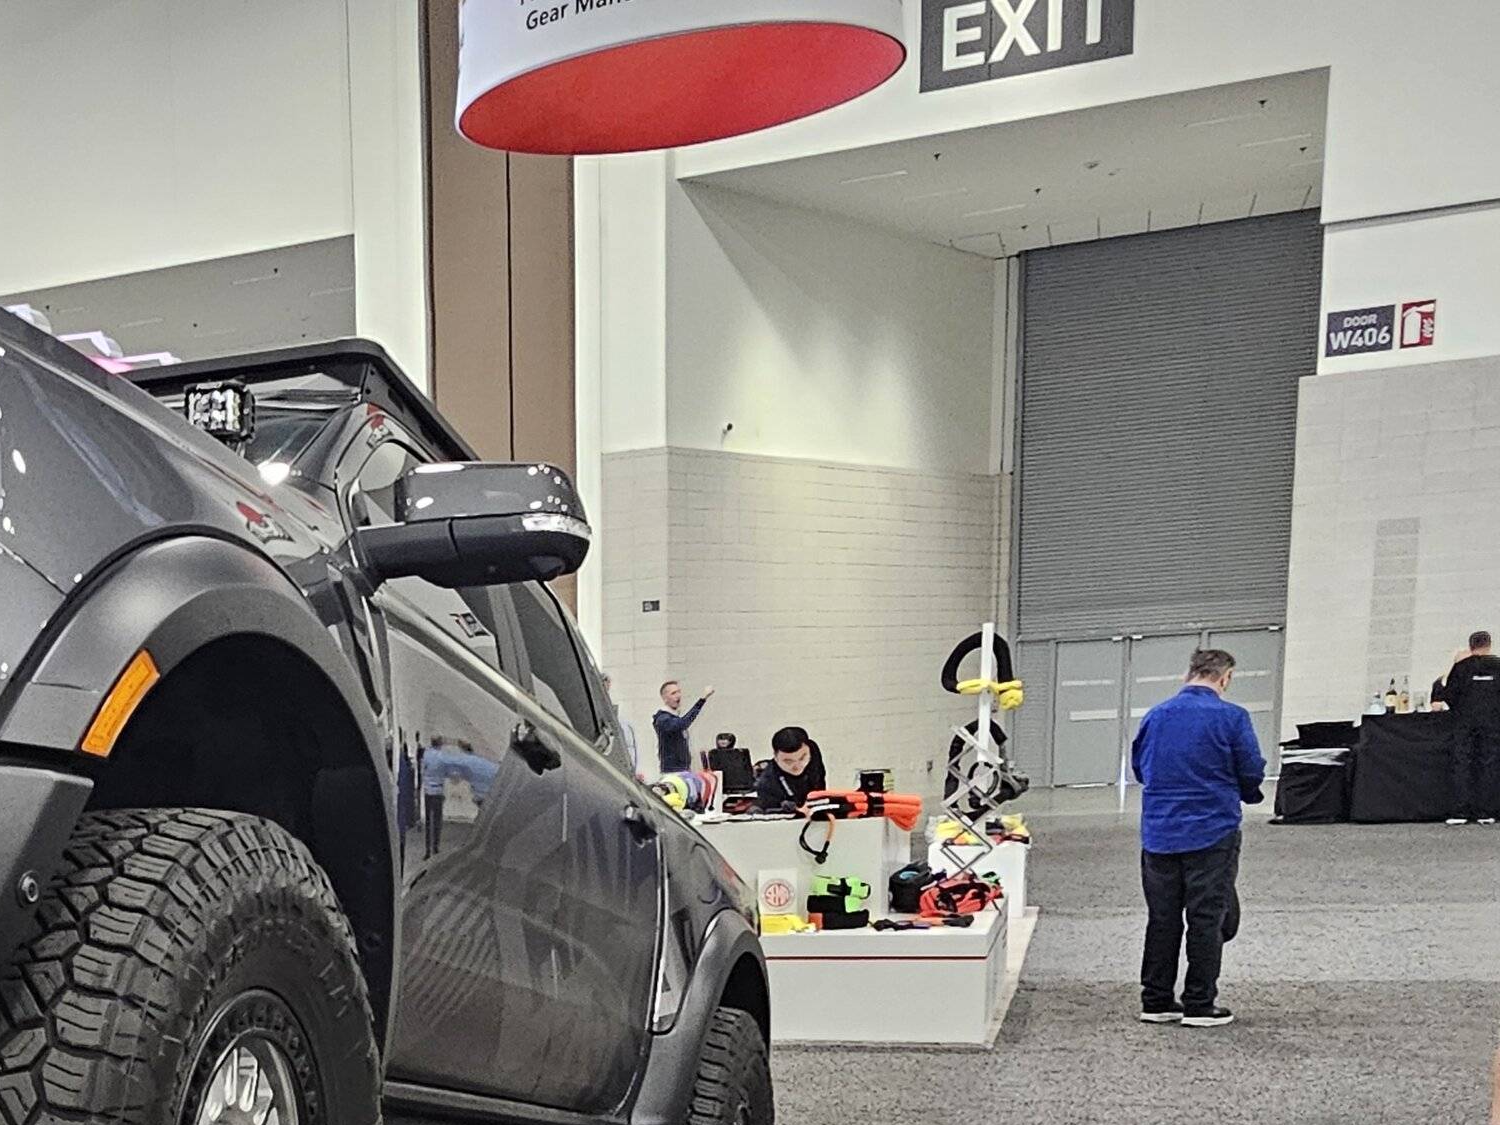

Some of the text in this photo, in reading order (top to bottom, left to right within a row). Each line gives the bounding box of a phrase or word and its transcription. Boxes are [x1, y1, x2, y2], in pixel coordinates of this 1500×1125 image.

[525, 3, 569, 30] Gear
[942, 0, 1103, 72] EXIT
[1343, 313, 1378, 328] DOOR
[1329, 326, 1391, 351] W406
